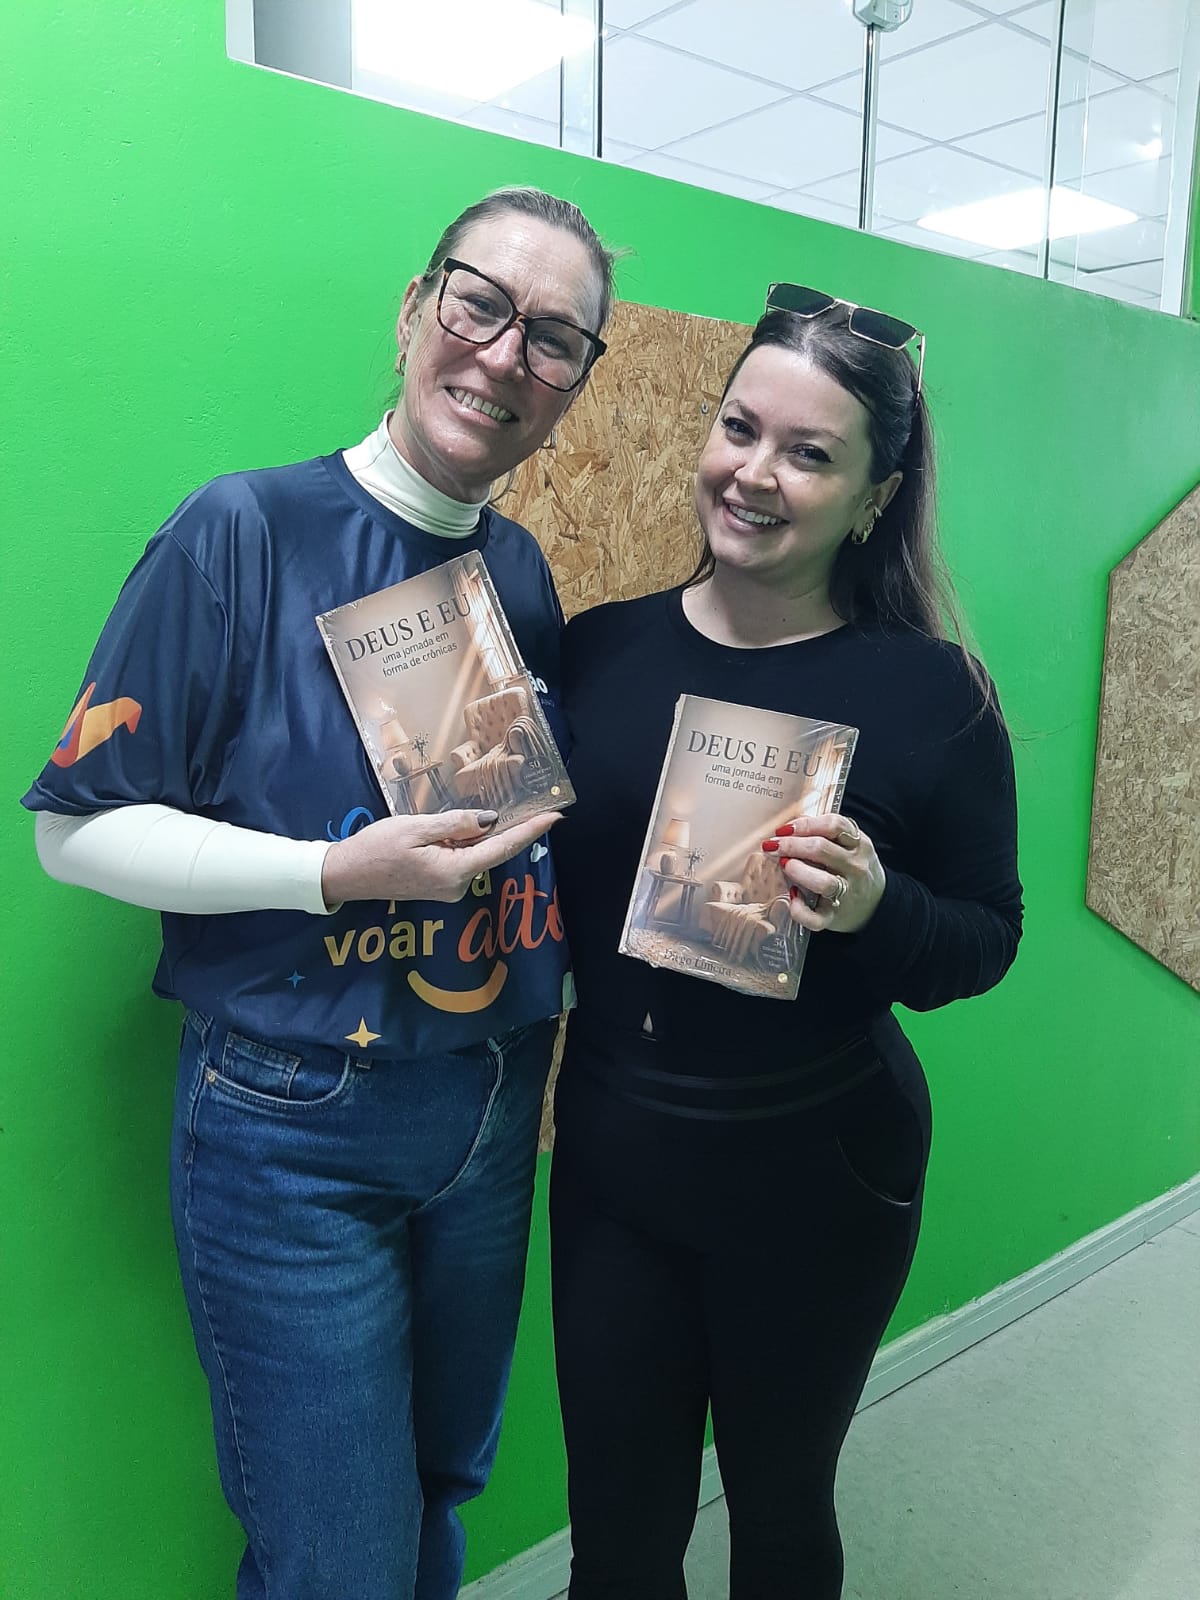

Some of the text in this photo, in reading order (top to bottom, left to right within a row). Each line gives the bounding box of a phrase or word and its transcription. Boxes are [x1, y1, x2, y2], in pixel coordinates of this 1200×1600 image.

[344, 593, 471, 662] DEUS E EU
[382, 631, 449, 664] uma jornada em
[382, 642, 458, 678] forma de crônicas
[686, 730, 822, 777] DEUS E EU
[704, 773, 784, 799] forma de crônicas
[711, 762, 783, 785] uma jornada em
[324, 919, 444, 966] voar
[457, 873, 564, 963] alto
